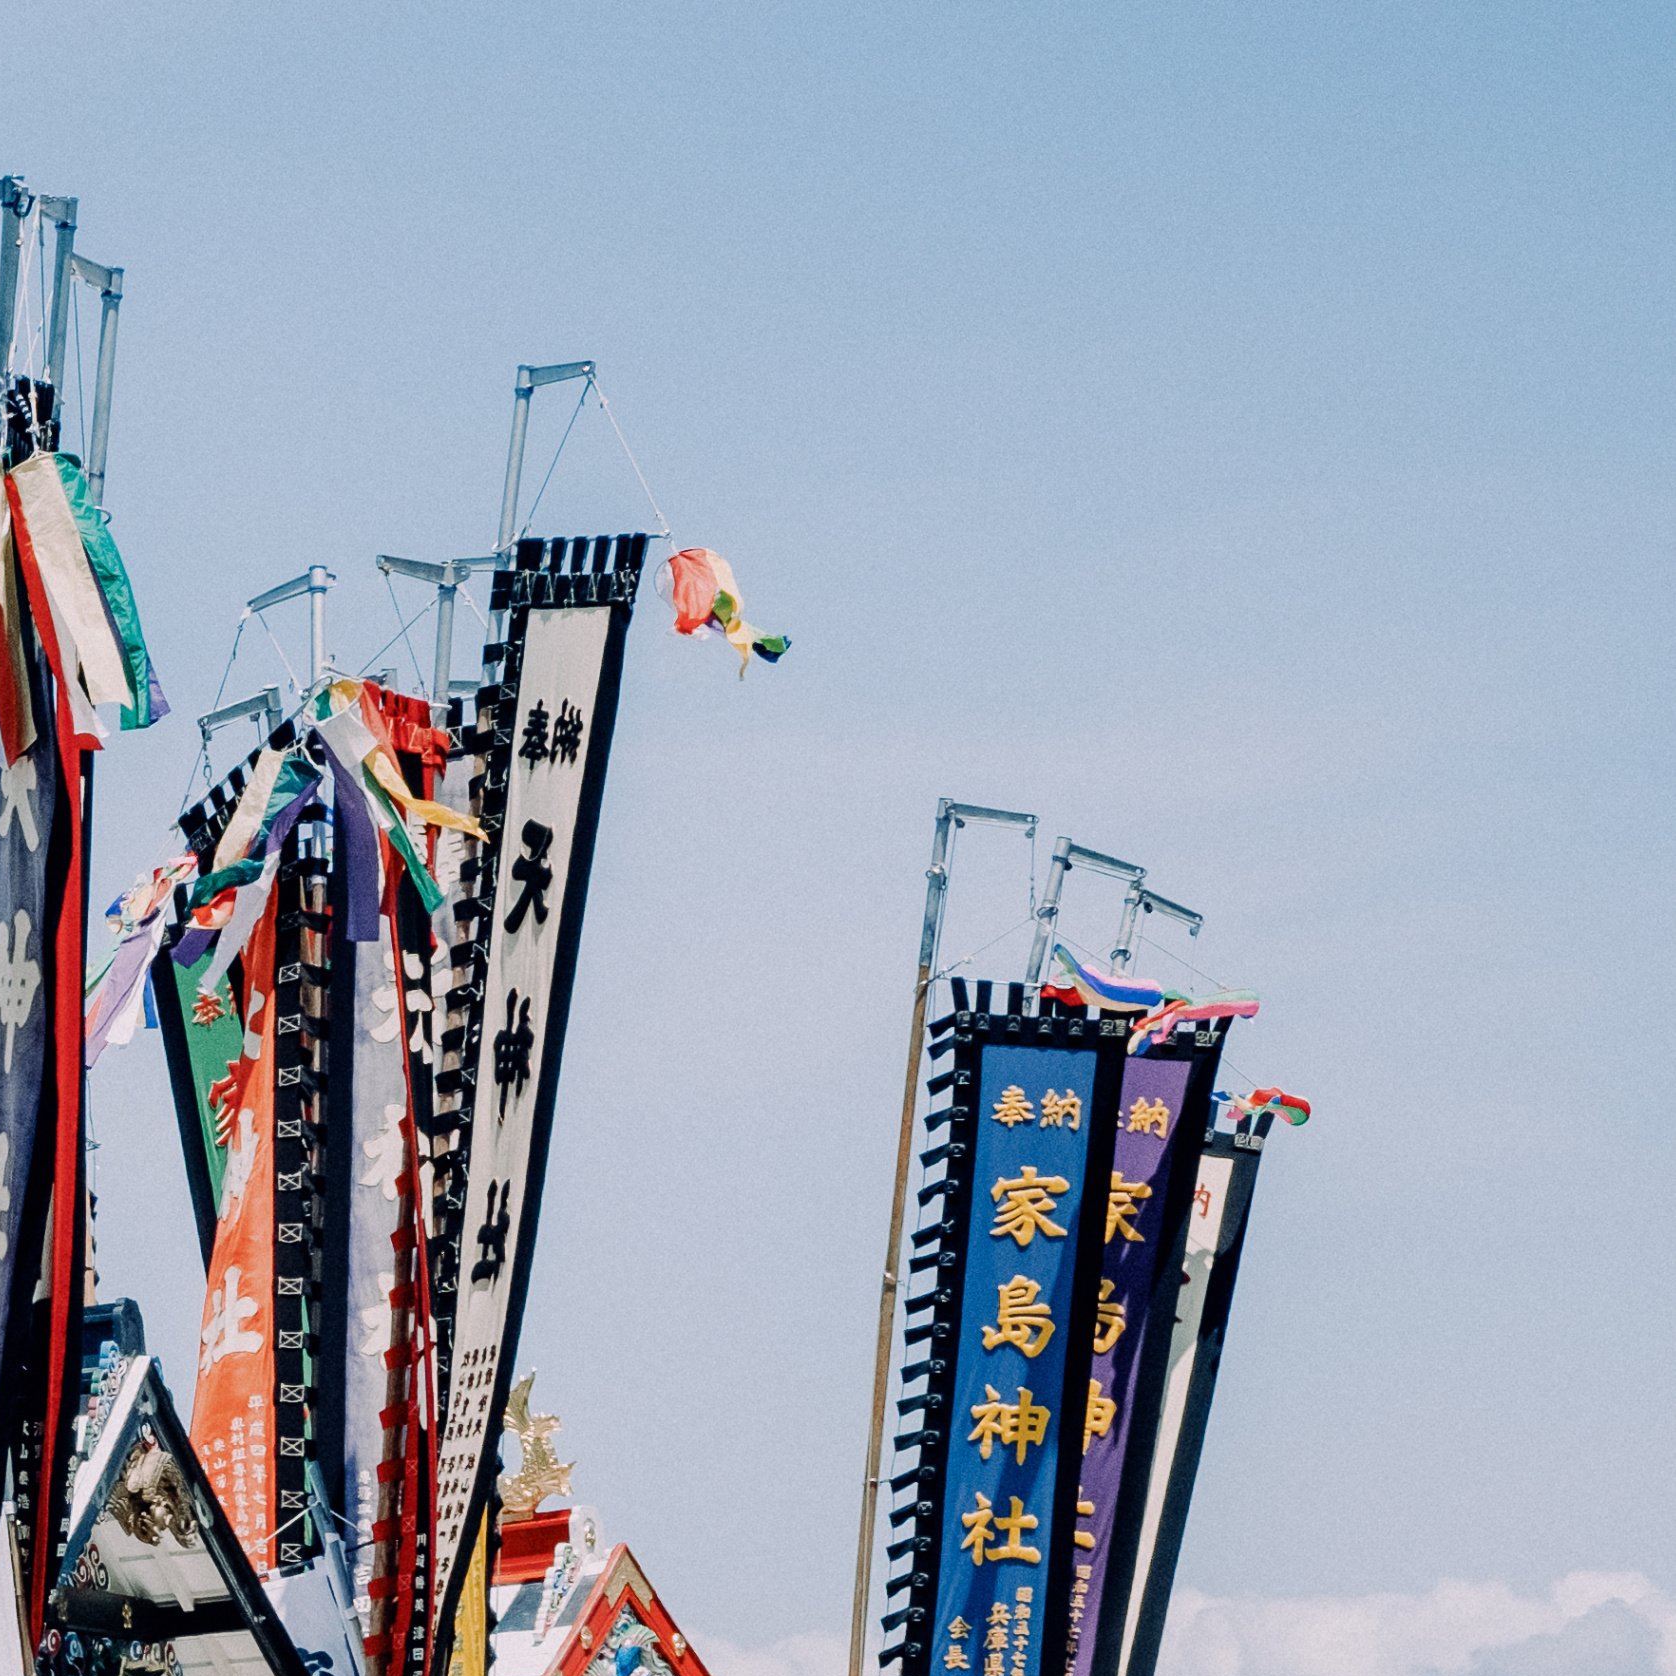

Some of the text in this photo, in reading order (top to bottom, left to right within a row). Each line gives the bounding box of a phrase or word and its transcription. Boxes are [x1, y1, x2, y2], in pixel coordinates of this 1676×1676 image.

[518, 698, 584, 769] 奉納
[990, 1085, 1083, 1130] 奉納
[961, 1165, 1070, 1567] 家島神社
[942, 1615, 973, 1671] 会長
